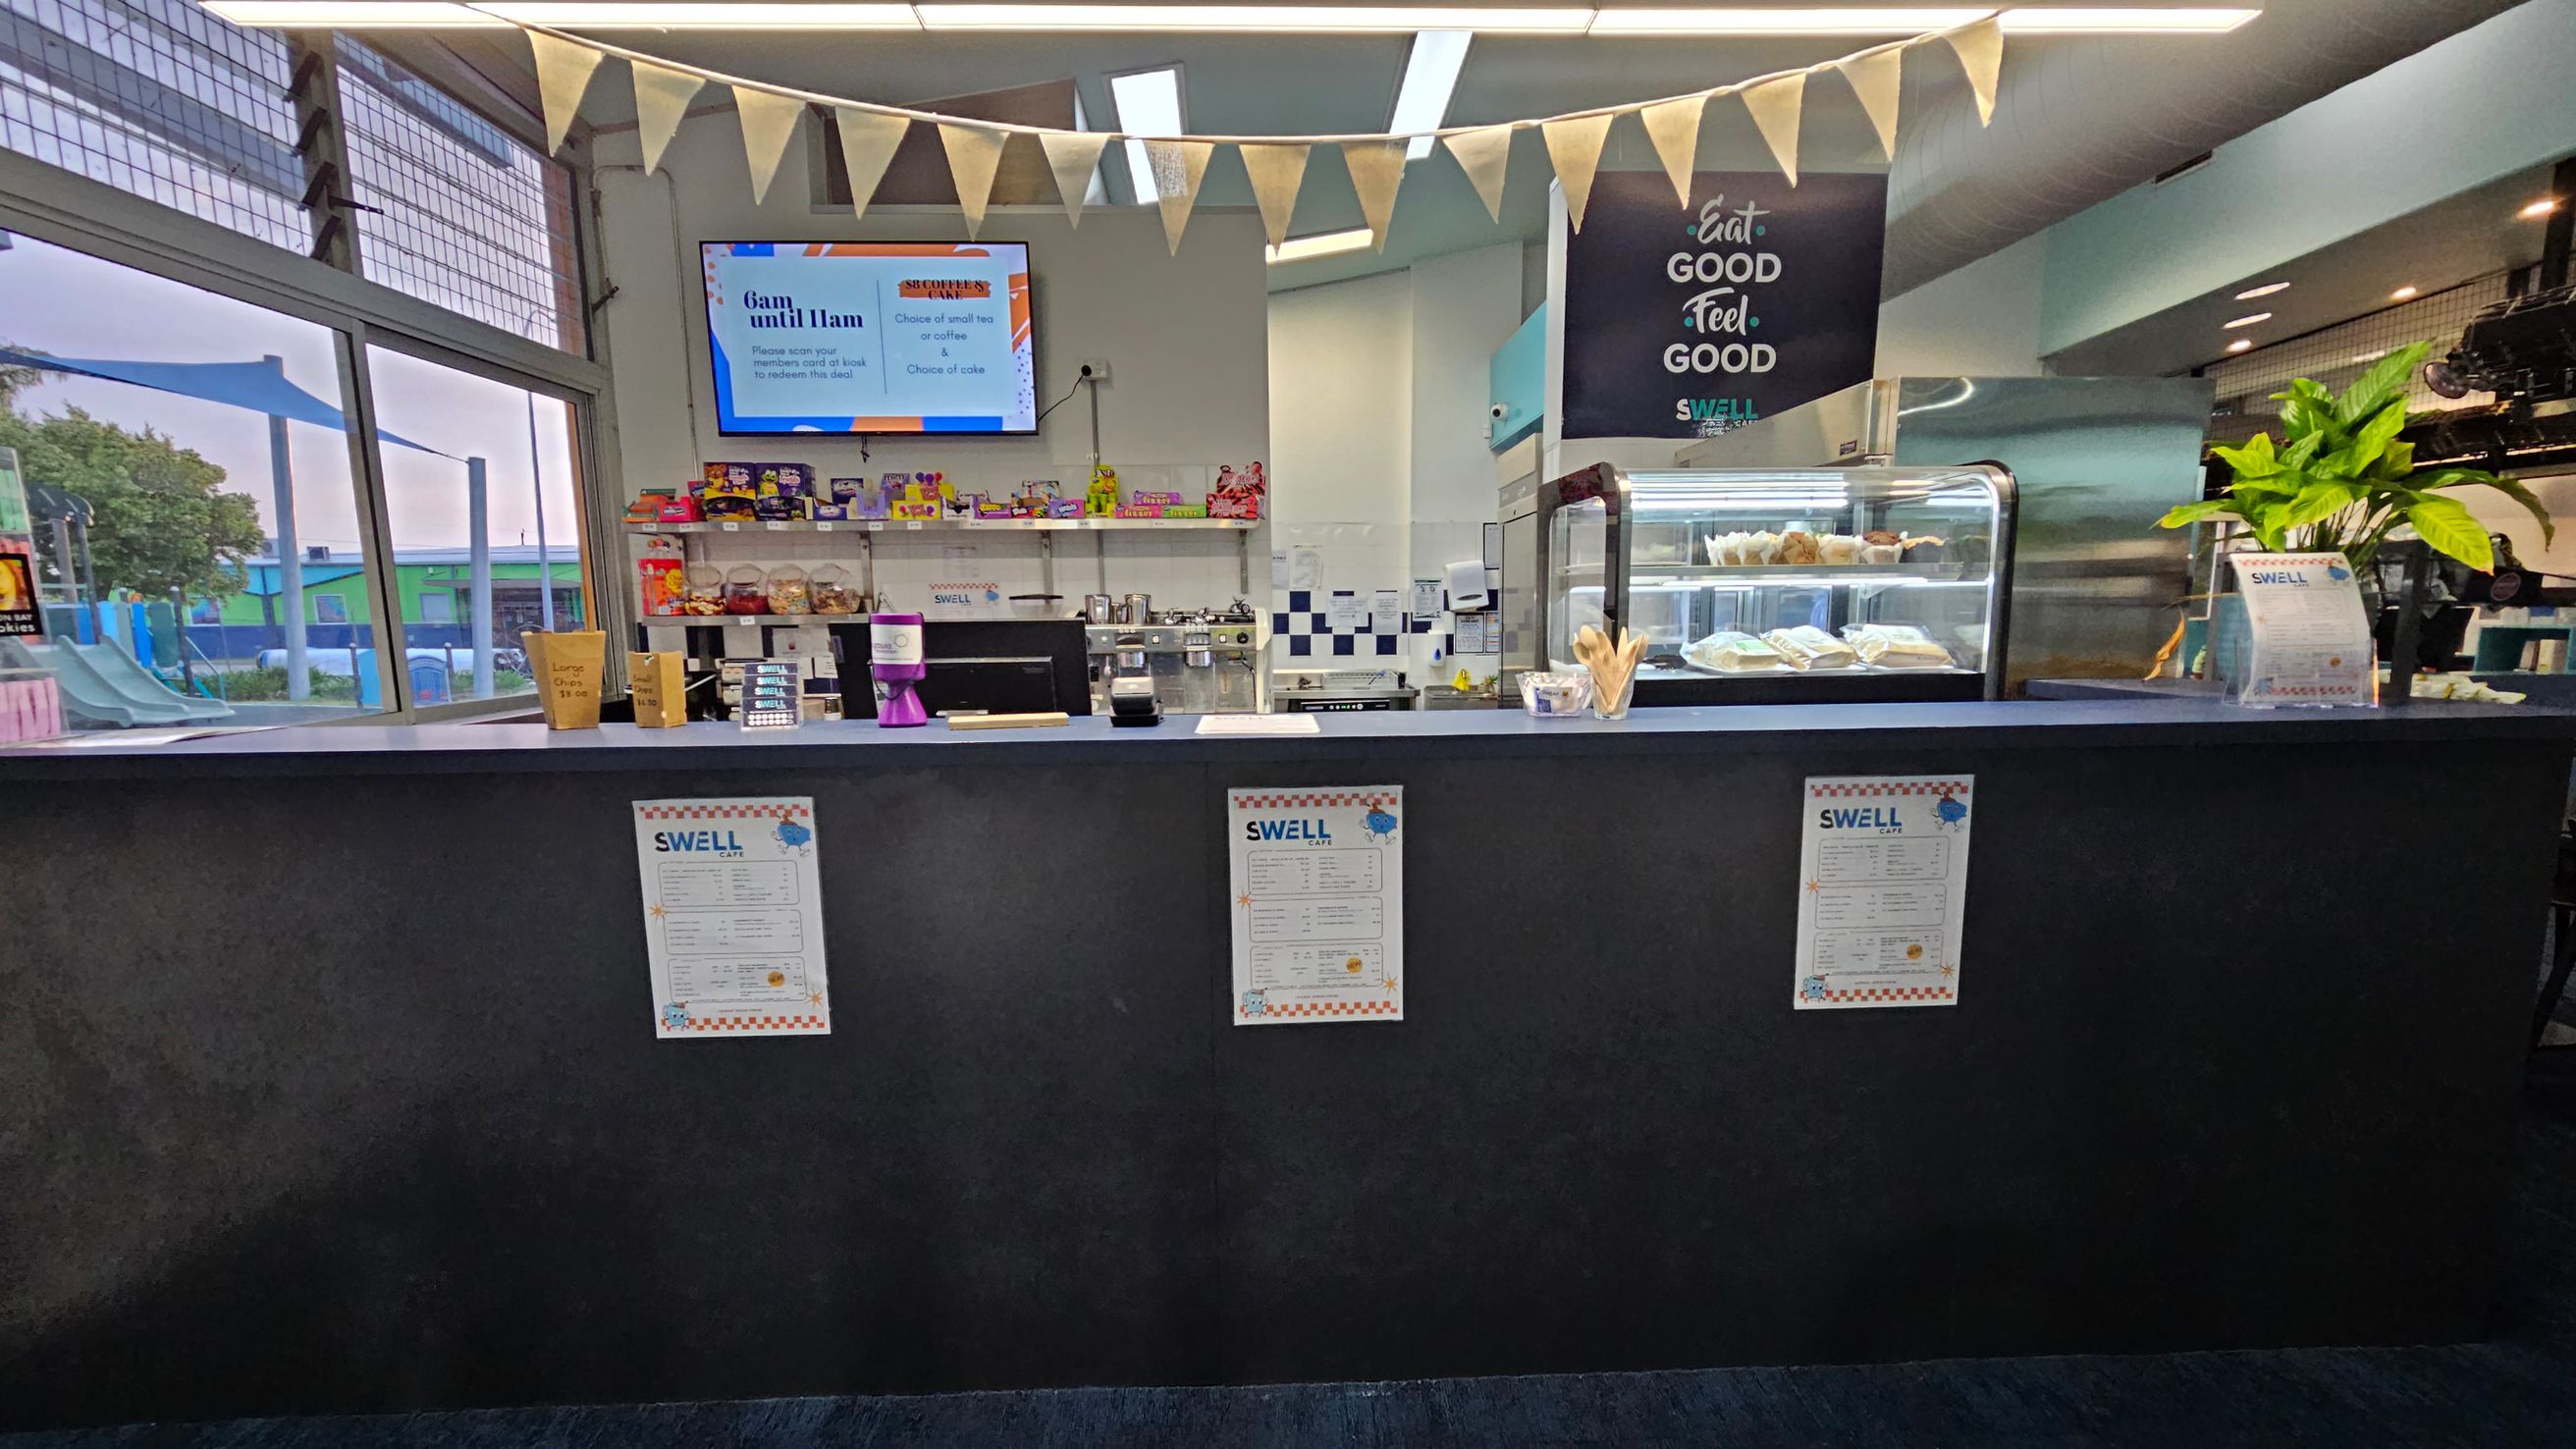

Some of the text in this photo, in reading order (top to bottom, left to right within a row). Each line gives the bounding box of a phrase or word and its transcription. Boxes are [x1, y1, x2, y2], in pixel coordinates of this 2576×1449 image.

[1697, 194, 1771, 245] Eat
[1666, 251, 1782, 284] GOOD
[922, 279, 972, 291] COFFEE
[743, 290, 793, 311] 6am
[929, 291, 962, 300] CAKE
[749, 307, 864, 329] until 11am
[1682, 287, 1749, 337] Feel
[894, 313, 994, 324] Choice of small tea
[920, 331, 968, 341] or coffee
[752, 345, 837, 359] Please scan your
[940, 348, 949, 357] &
[753, 357, 867, 368] members card at kiosk
[1662, 343, 1778, 374] GOOD
[754, 369, 853, 380] to redeem this deal
[906, 364, 986, 375] Choice of cake
[1675, 398, 1759, 421] SWELL
[2252, 571, 2308, 585] SWELL
[935, 594, 972, 604] SWELL
[552, 662, 586, 677] Large
[757, 665, 786, 673] SWELL
[553, 677, 583, 688] Chips
[756, 676, 786, 685] SWELL
[754, 686, 784, 696] SWELL
[754, 699, 784, 709] SWELL
[1819, 807, 1903, 830] SWELL
[1246, 819, 1332, 841] SWELL
[654, 831, 743, 853] SWELL
